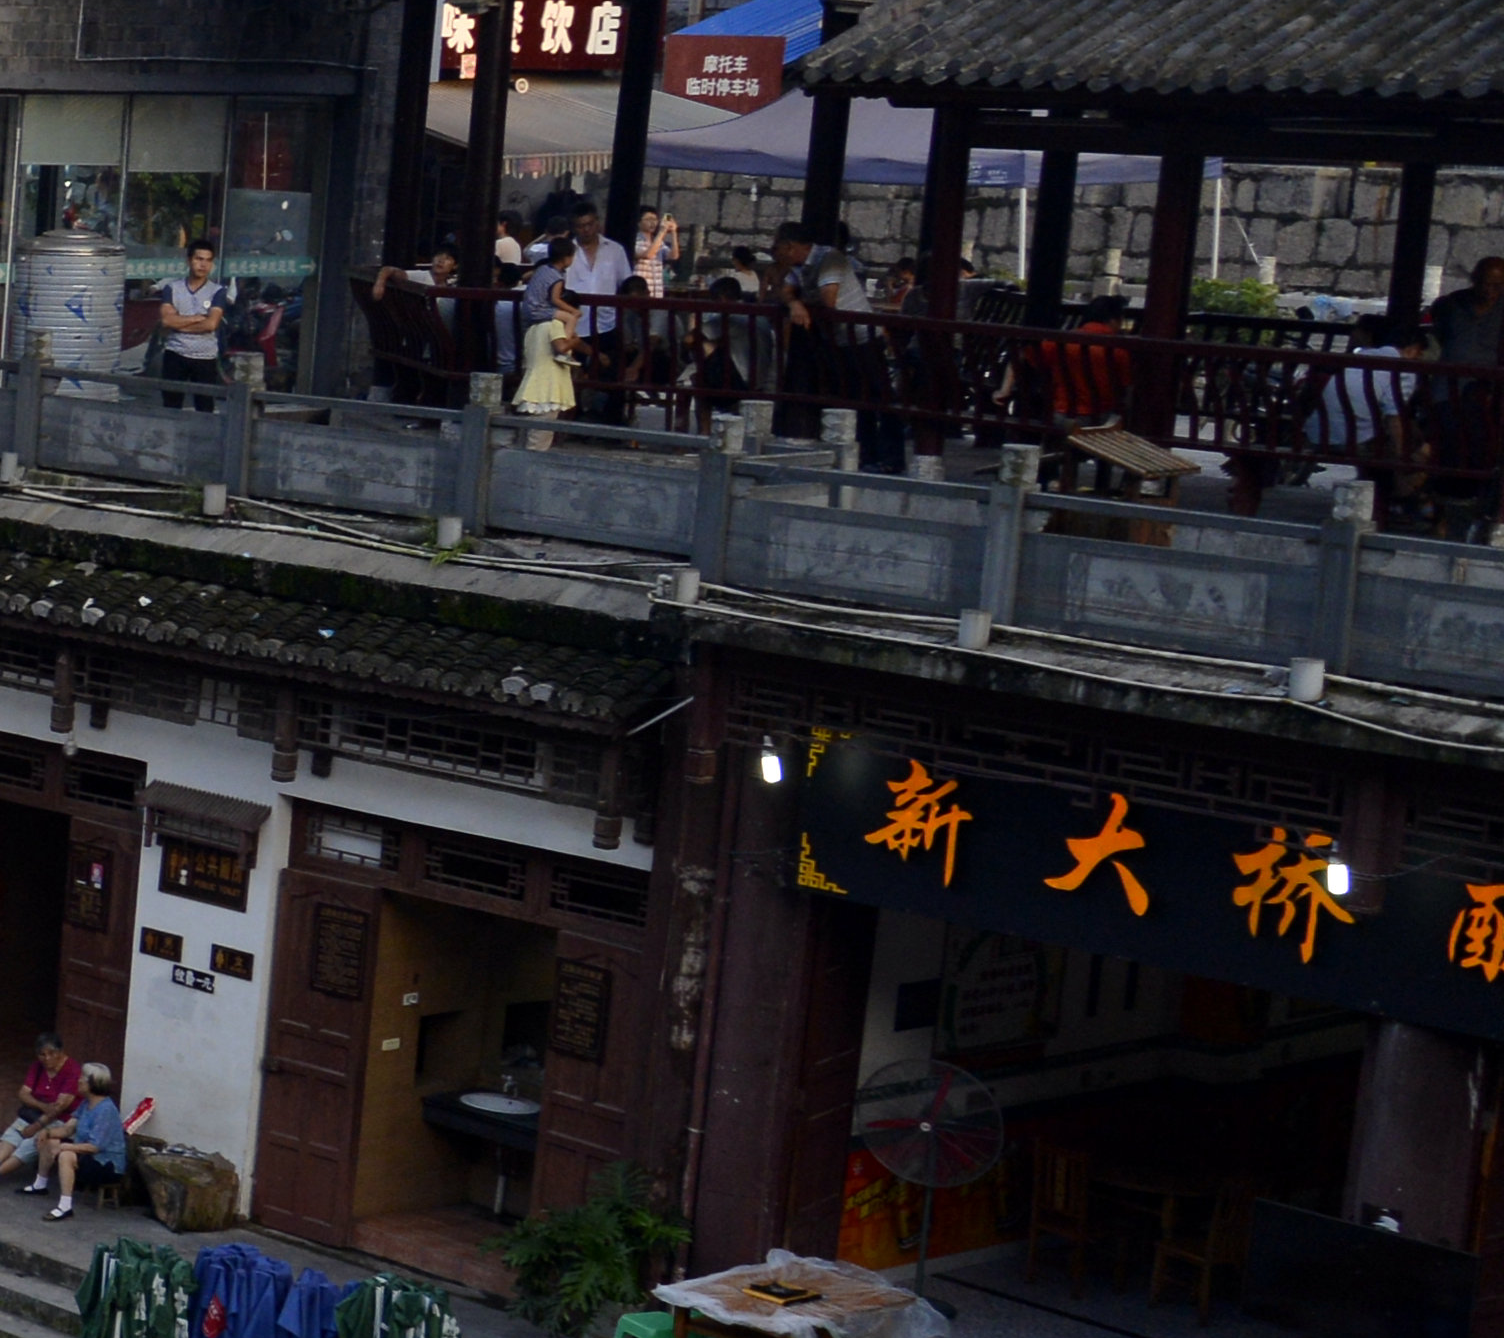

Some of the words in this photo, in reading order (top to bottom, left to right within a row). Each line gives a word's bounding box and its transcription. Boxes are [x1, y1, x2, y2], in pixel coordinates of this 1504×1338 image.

[702, 54, 747, 74] 摩托车
[686, 77, 760, 97] 临时停车场
